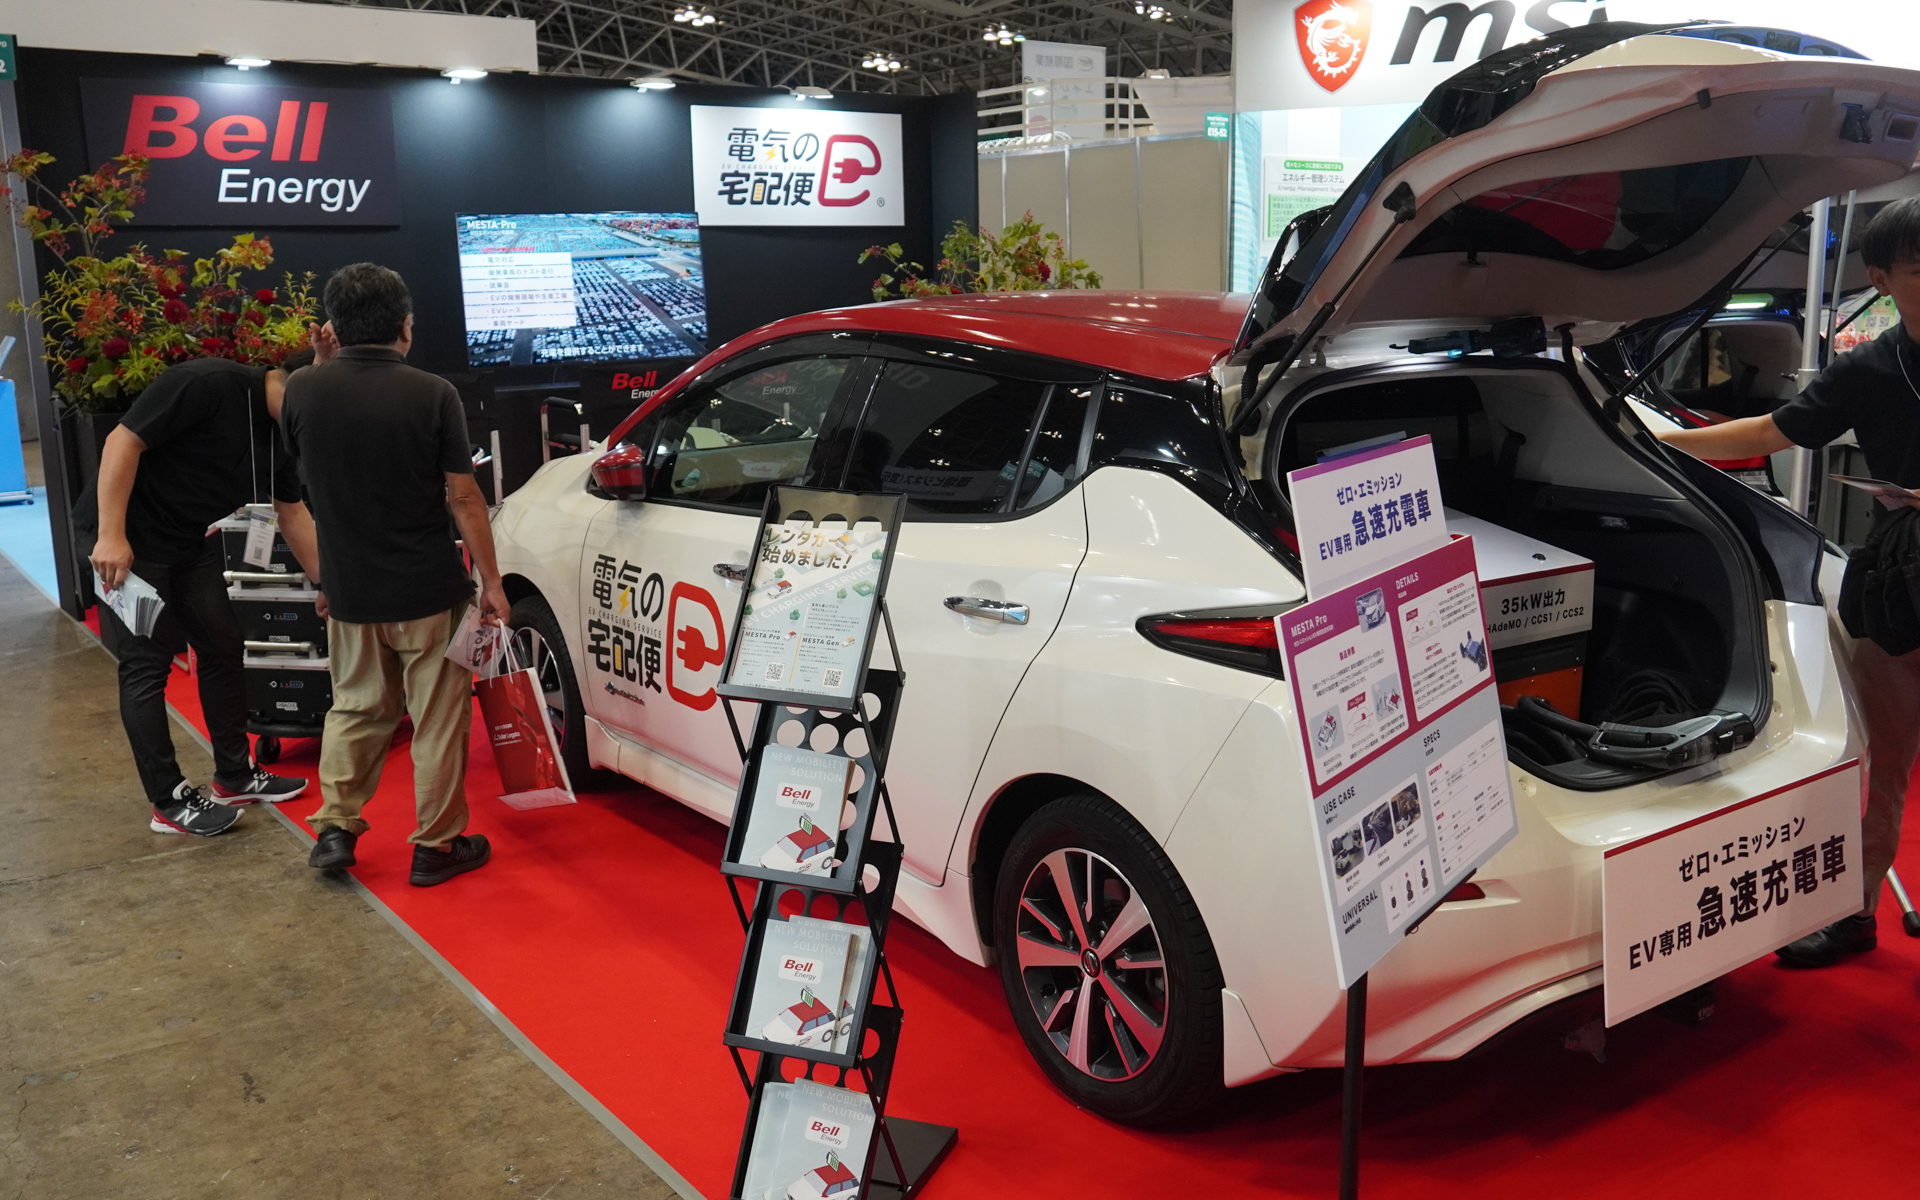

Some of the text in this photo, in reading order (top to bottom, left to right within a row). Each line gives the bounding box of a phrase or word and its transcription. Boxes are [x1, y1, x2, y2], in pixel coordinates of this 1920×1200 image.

[123, 94, 328, 162] Bell
[727, 127, 820, 162] 電気の
[717, 170, 816, 206] 宅配便
[1282, 173, 1344, 184] エネルギー管理システム
[218, 168, 371, 212] Energy
[611, 370, 658, 390] Bell
[1336, 472, 1402, 506] ゼロ・エミッション
[1319, 488, 1432, 561] EV専用 急速充電車
[768, 528, 838, 548] レンタカー
[592, 554, 664, 622] 電気の
[760, 587, 826, 618] CHARGING
[826, 562, 877, 593] SERVICE
[1395, 570, 1419, 590] DETAILS
[1501, 588, 1566, 616] 35kW出力
[588, 606, 662, 639] EV CHARGING SERVICE
[1290, 611, 1327, 638] MESTA Pro
[1531, 612, 1552, 627] CCS1
[1562, 606, 1584, 620] CCS2
[587, 618, 662, 694] 宅配便
[1423, 728, 1440, 748] SPECS
[770, 752, 846, 770] NEW MOBILITY
[790, 767, 843, 783] SOLUTION
[781, 786, 812, 800] Bell
[792, 799, 815, 808] Energy
[1323, 784, 1355, 815] USE CASE
[1678, 816, 1806, 882] ゼロ・エミッション
[1342, 886, 1378, 925] UNIVERSAL
[1629, 834, 1846, 970] EV専用 急速充電車
[774, 924, 847, 944] NEW MOBILITY
[793, 940, 844, 957] SOLUTION
[784, 959, 814, 973] Bell
[794, 970, 817, 982] Energy
[802, 1084, 825, 1097] NEW
[821, 1102, 872, 1124] SOLUTION
[810, 1120, 841, 1137] Bell
[820, 1133, 843, 1146] Energy
